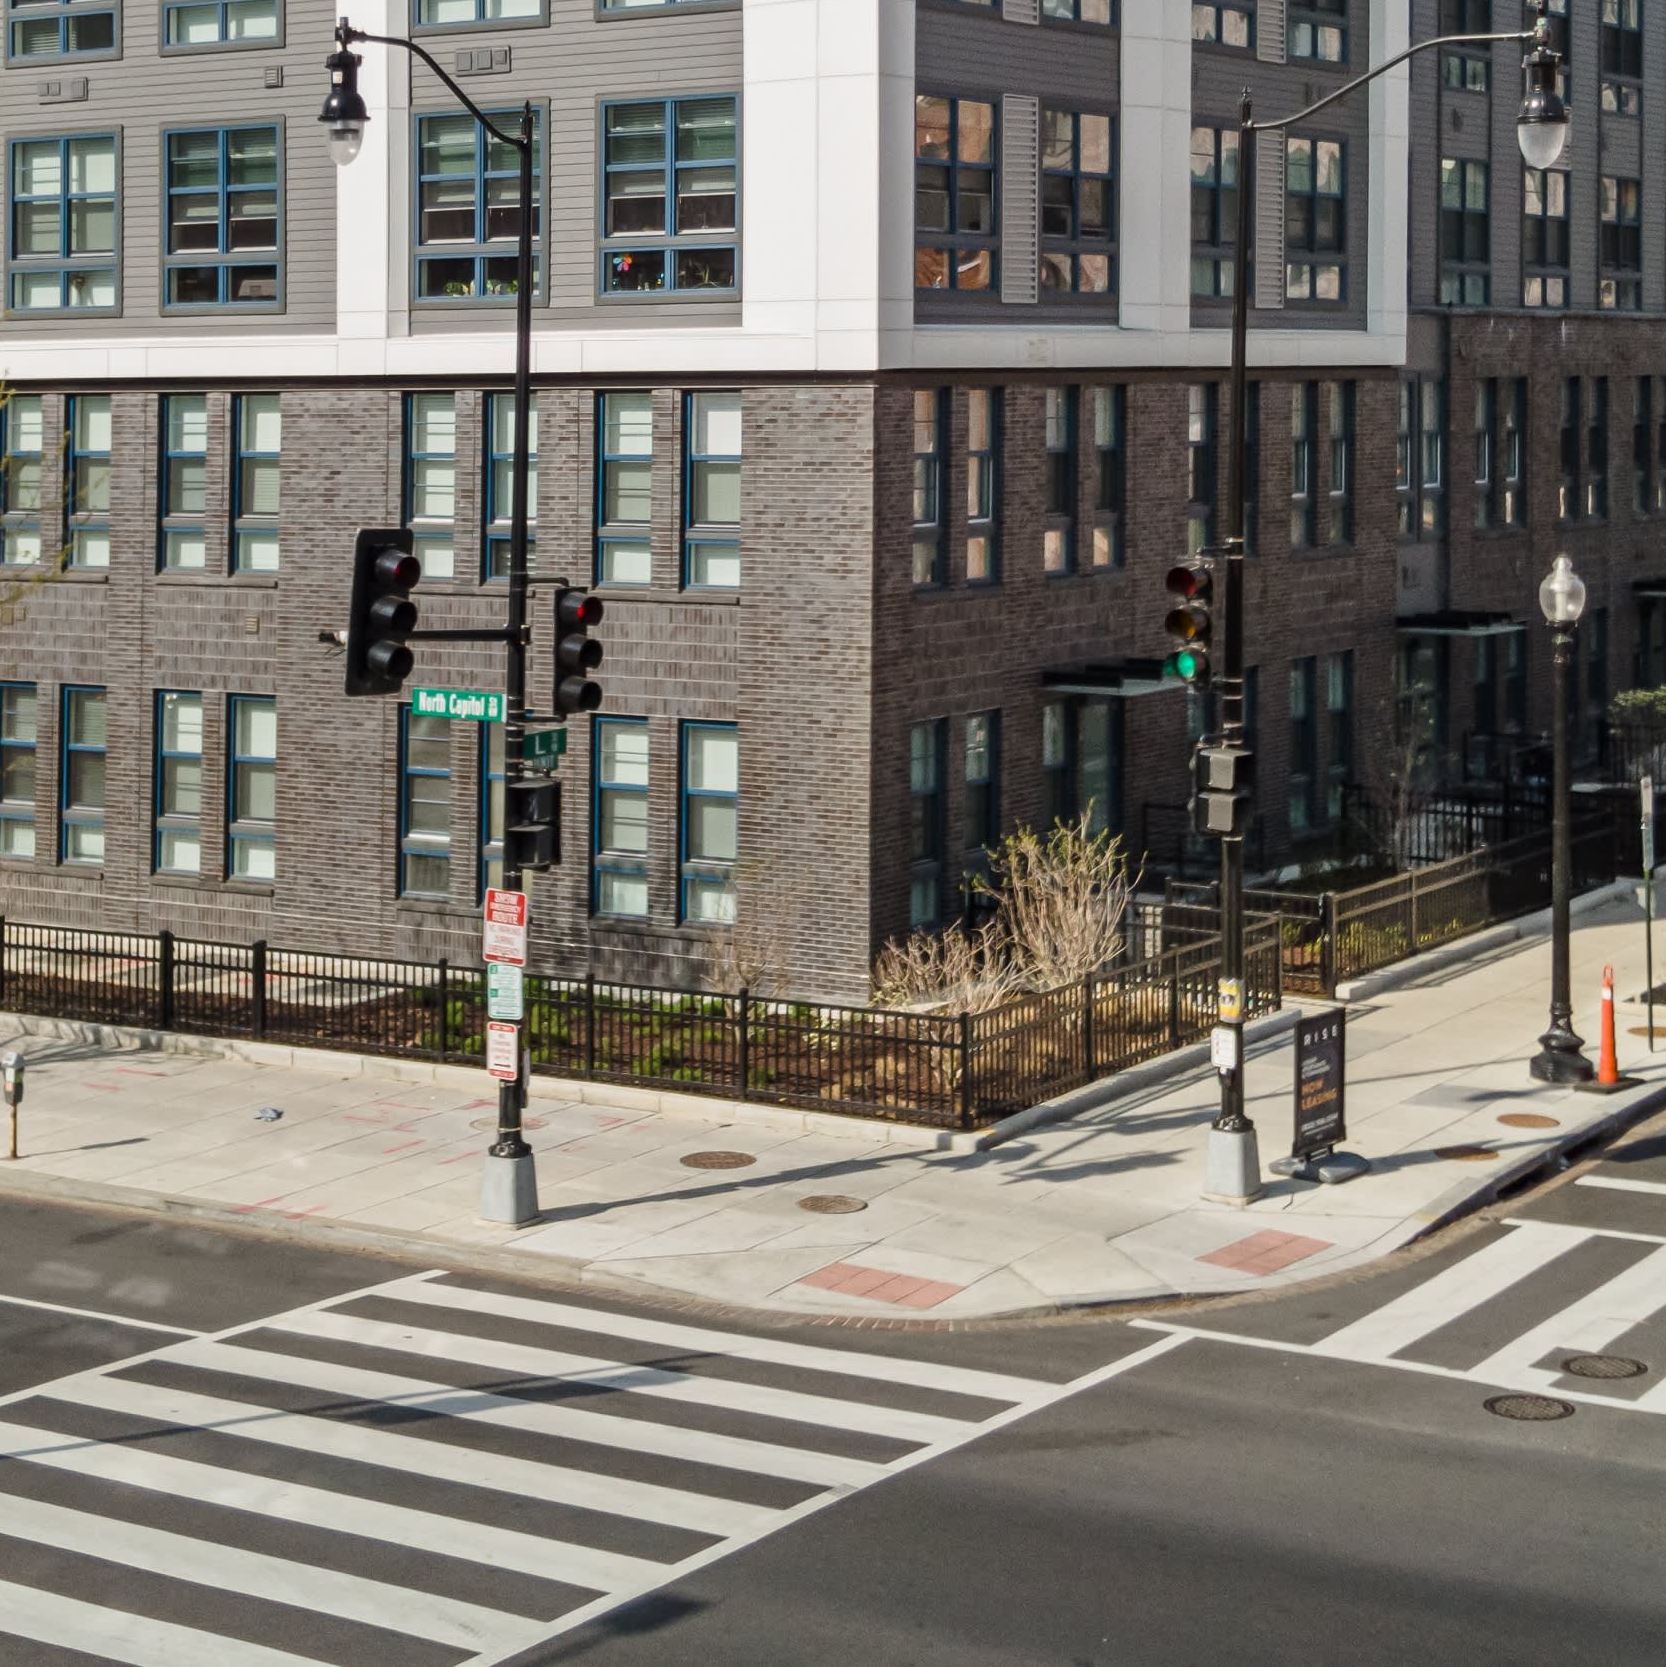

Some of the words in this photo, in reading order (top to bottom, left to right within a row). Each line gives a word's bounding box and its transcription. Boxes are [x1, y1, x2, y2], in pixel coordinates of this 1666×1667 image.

[418, 691, 446, 714] North
[449, 693, 485, 719] Capitol
[1303, 1024, 1338, 1047] RISE
[1301, 1078, 1324, 1095] NOW
[1301, 1087, 1338, 1111] LEASING
